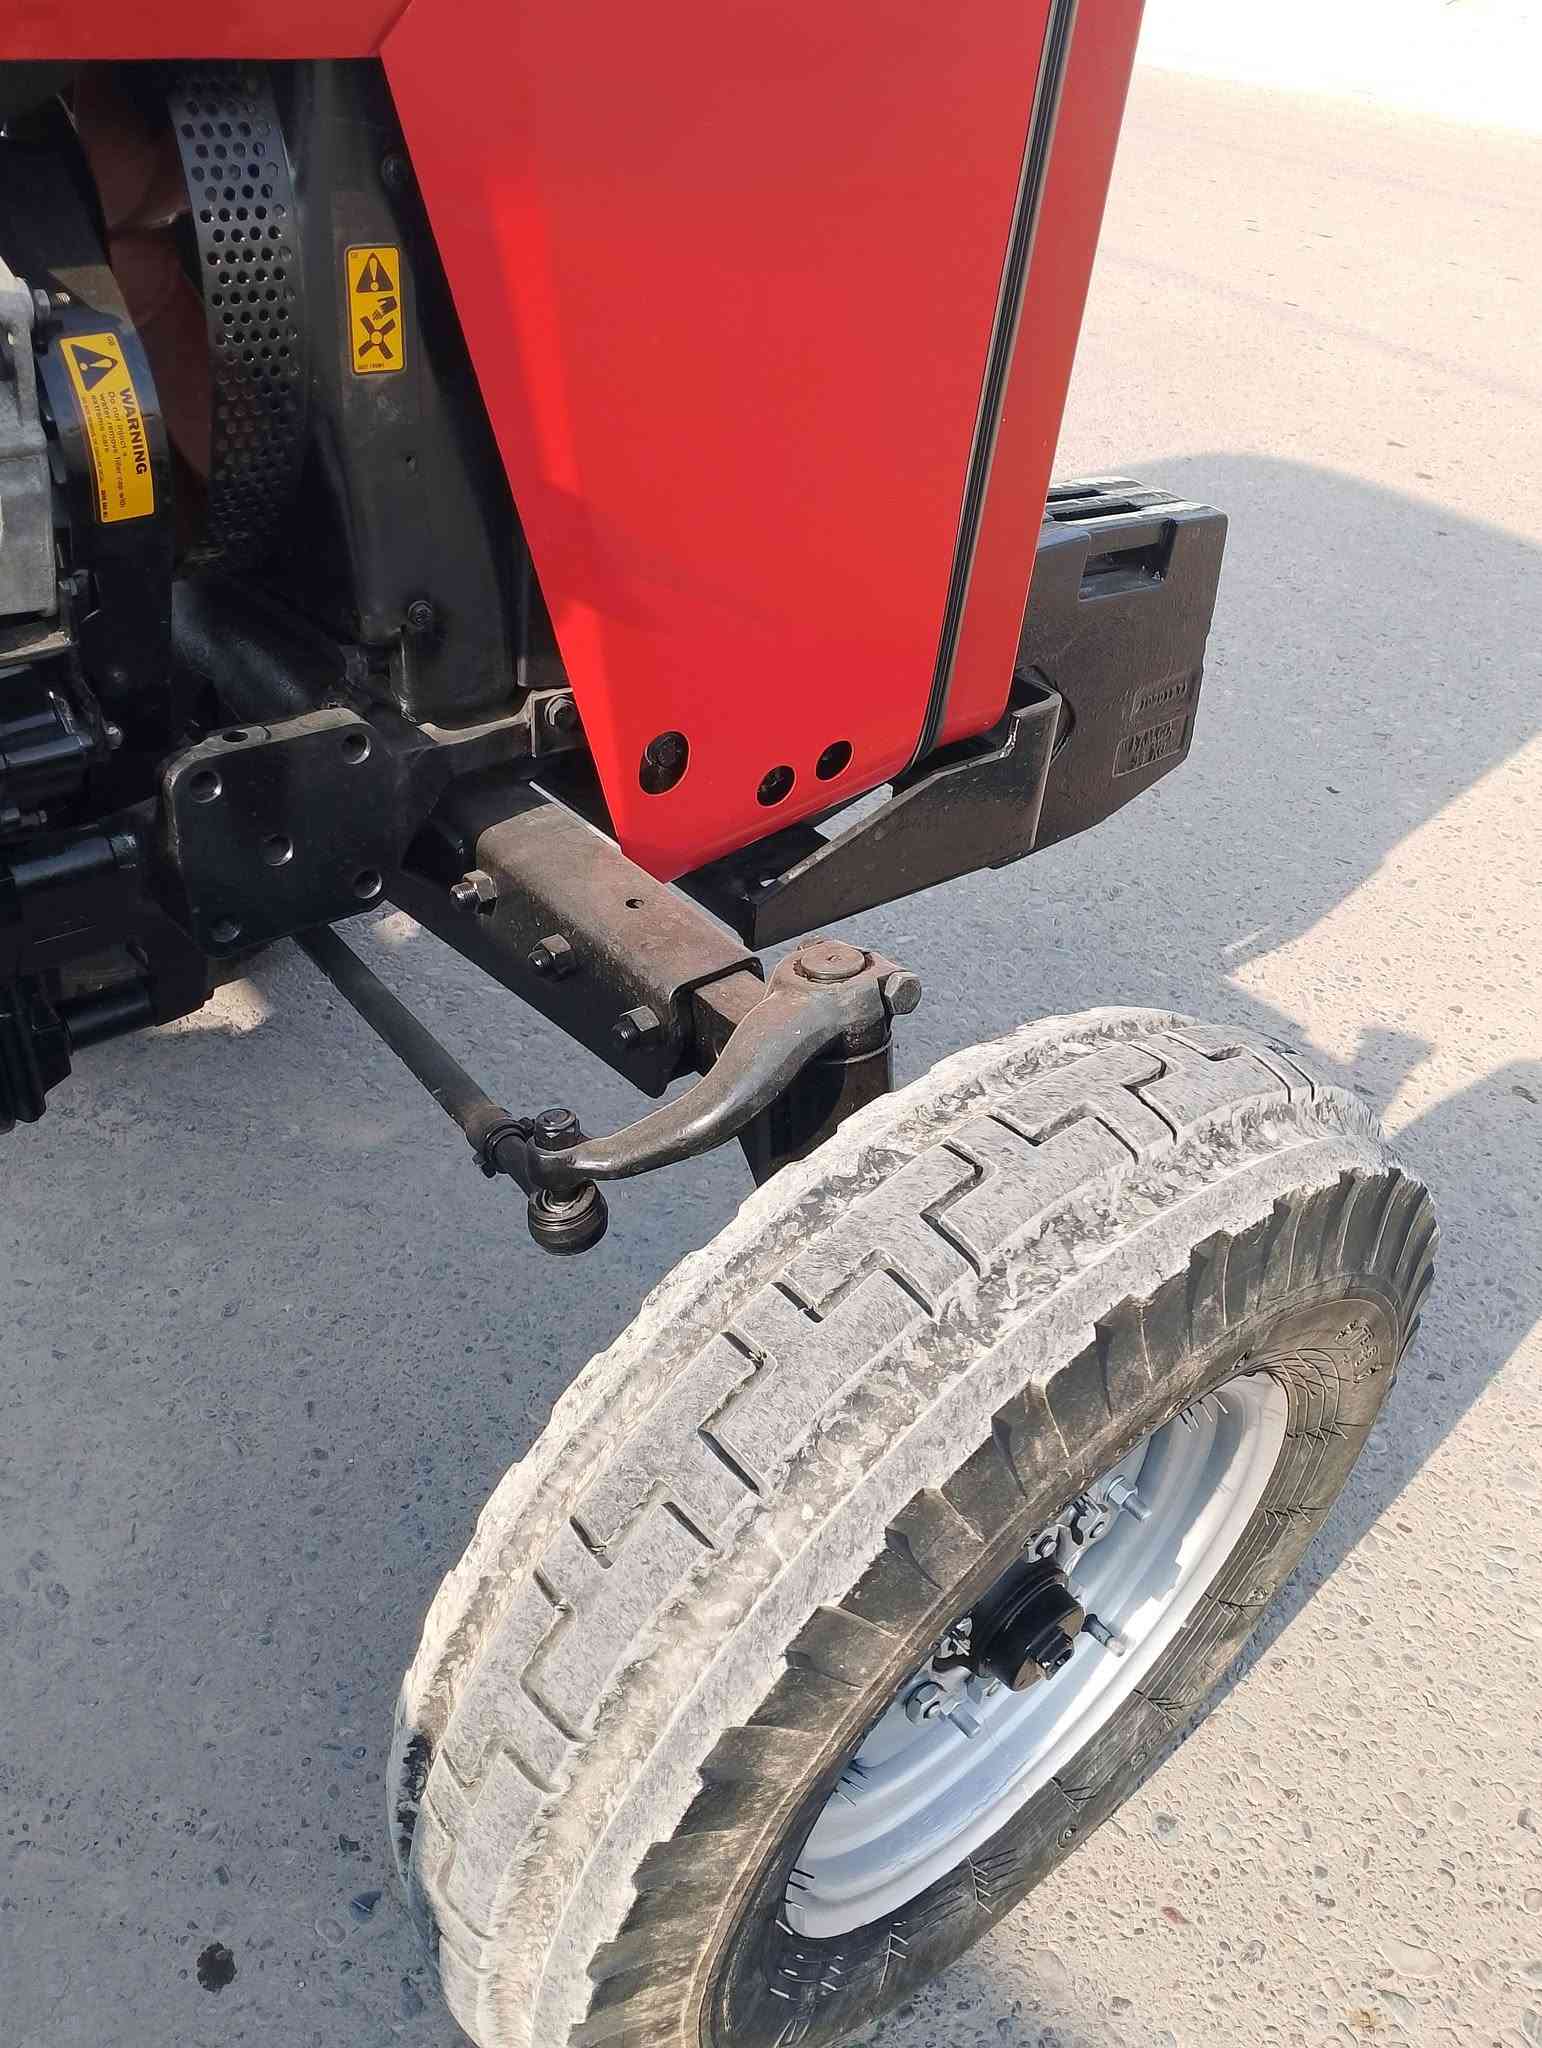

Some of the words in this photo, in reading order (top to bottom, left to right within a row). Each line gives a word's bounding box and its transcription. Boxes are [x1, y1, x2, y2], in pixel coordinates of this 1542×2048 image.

[98, 393, 111, 420] water
[106, 422, 117, 454] remove
[119, 387, 147, 475] WARNING
